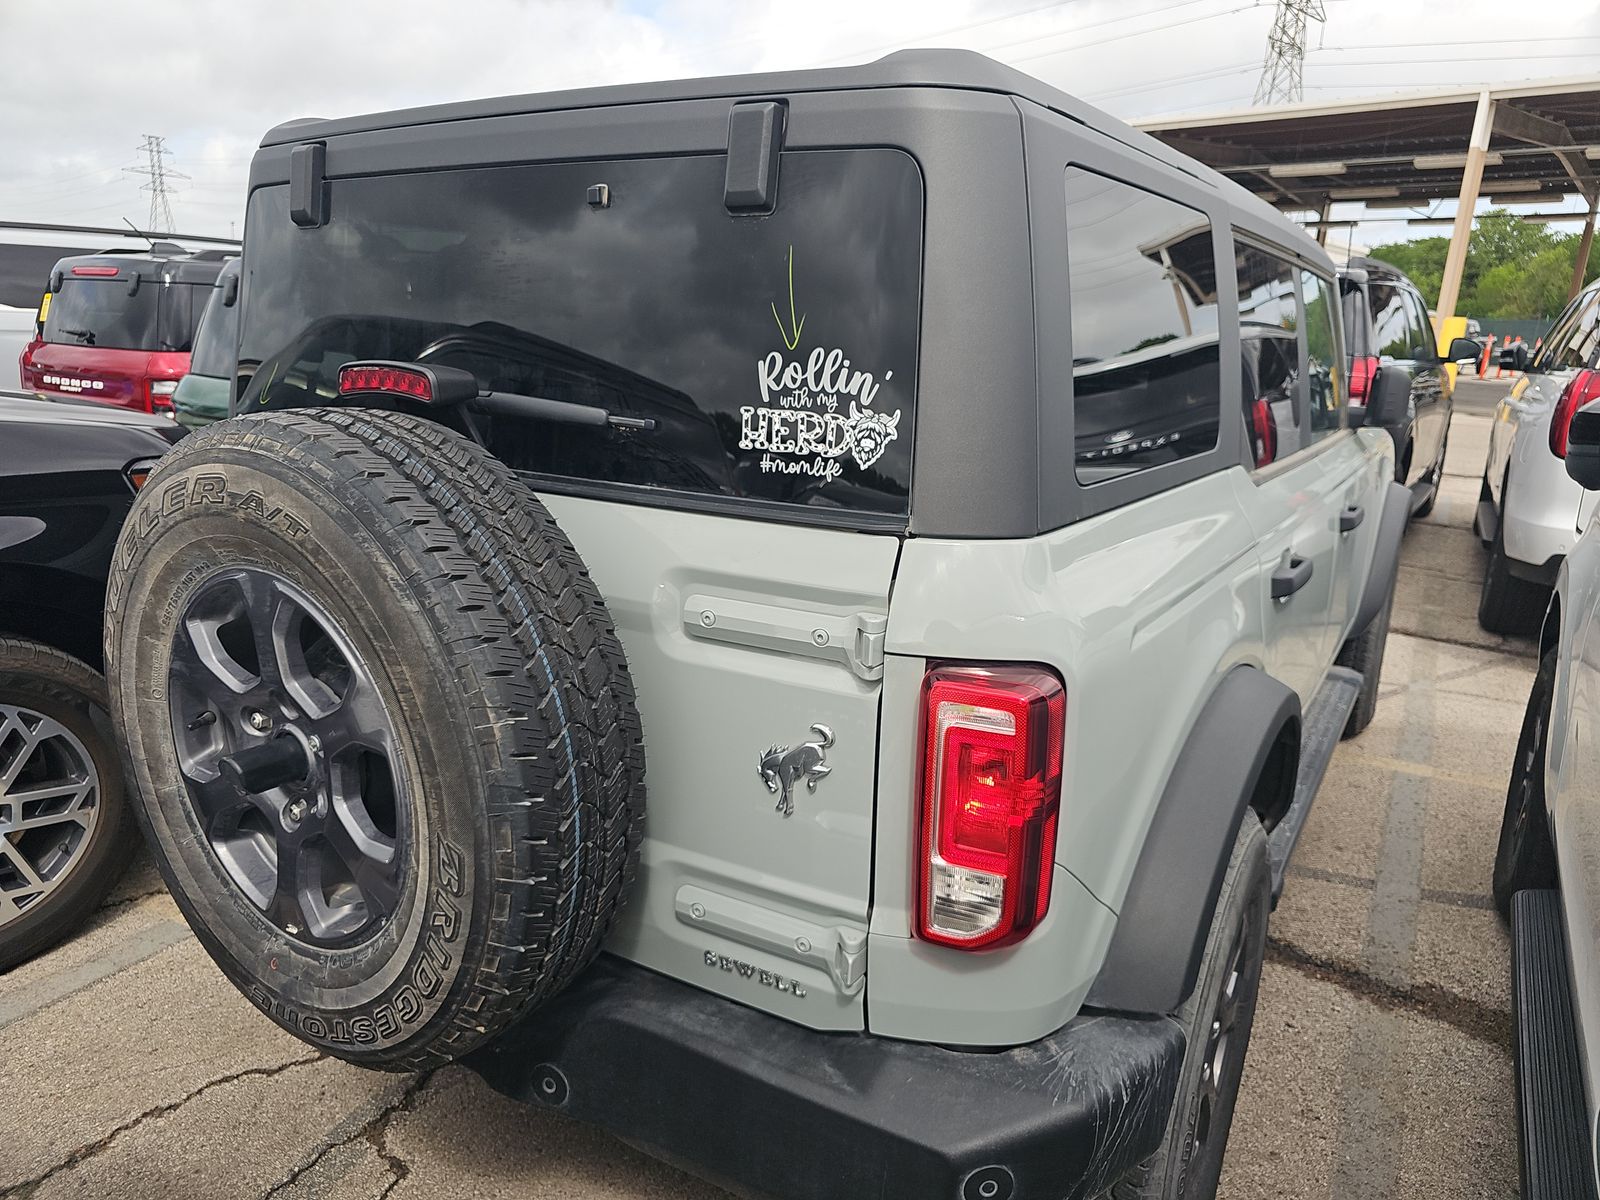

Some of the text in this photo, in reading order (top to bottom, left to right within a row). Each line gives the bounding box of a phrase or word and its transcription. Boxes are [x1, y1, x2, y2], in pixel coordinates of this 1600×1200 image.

[758, 347, 893, 406] Rollin'
[780, 387, 838, 412] with my
[738, 406, 852, 458] HERD
[759, 453, 843, 483] #momlife
[105, 472, 312, 665] DUELER A/T
[249, 831, 466, 1045] BRIDGESTONE
[704, 949, 807, 998] SEWELL
